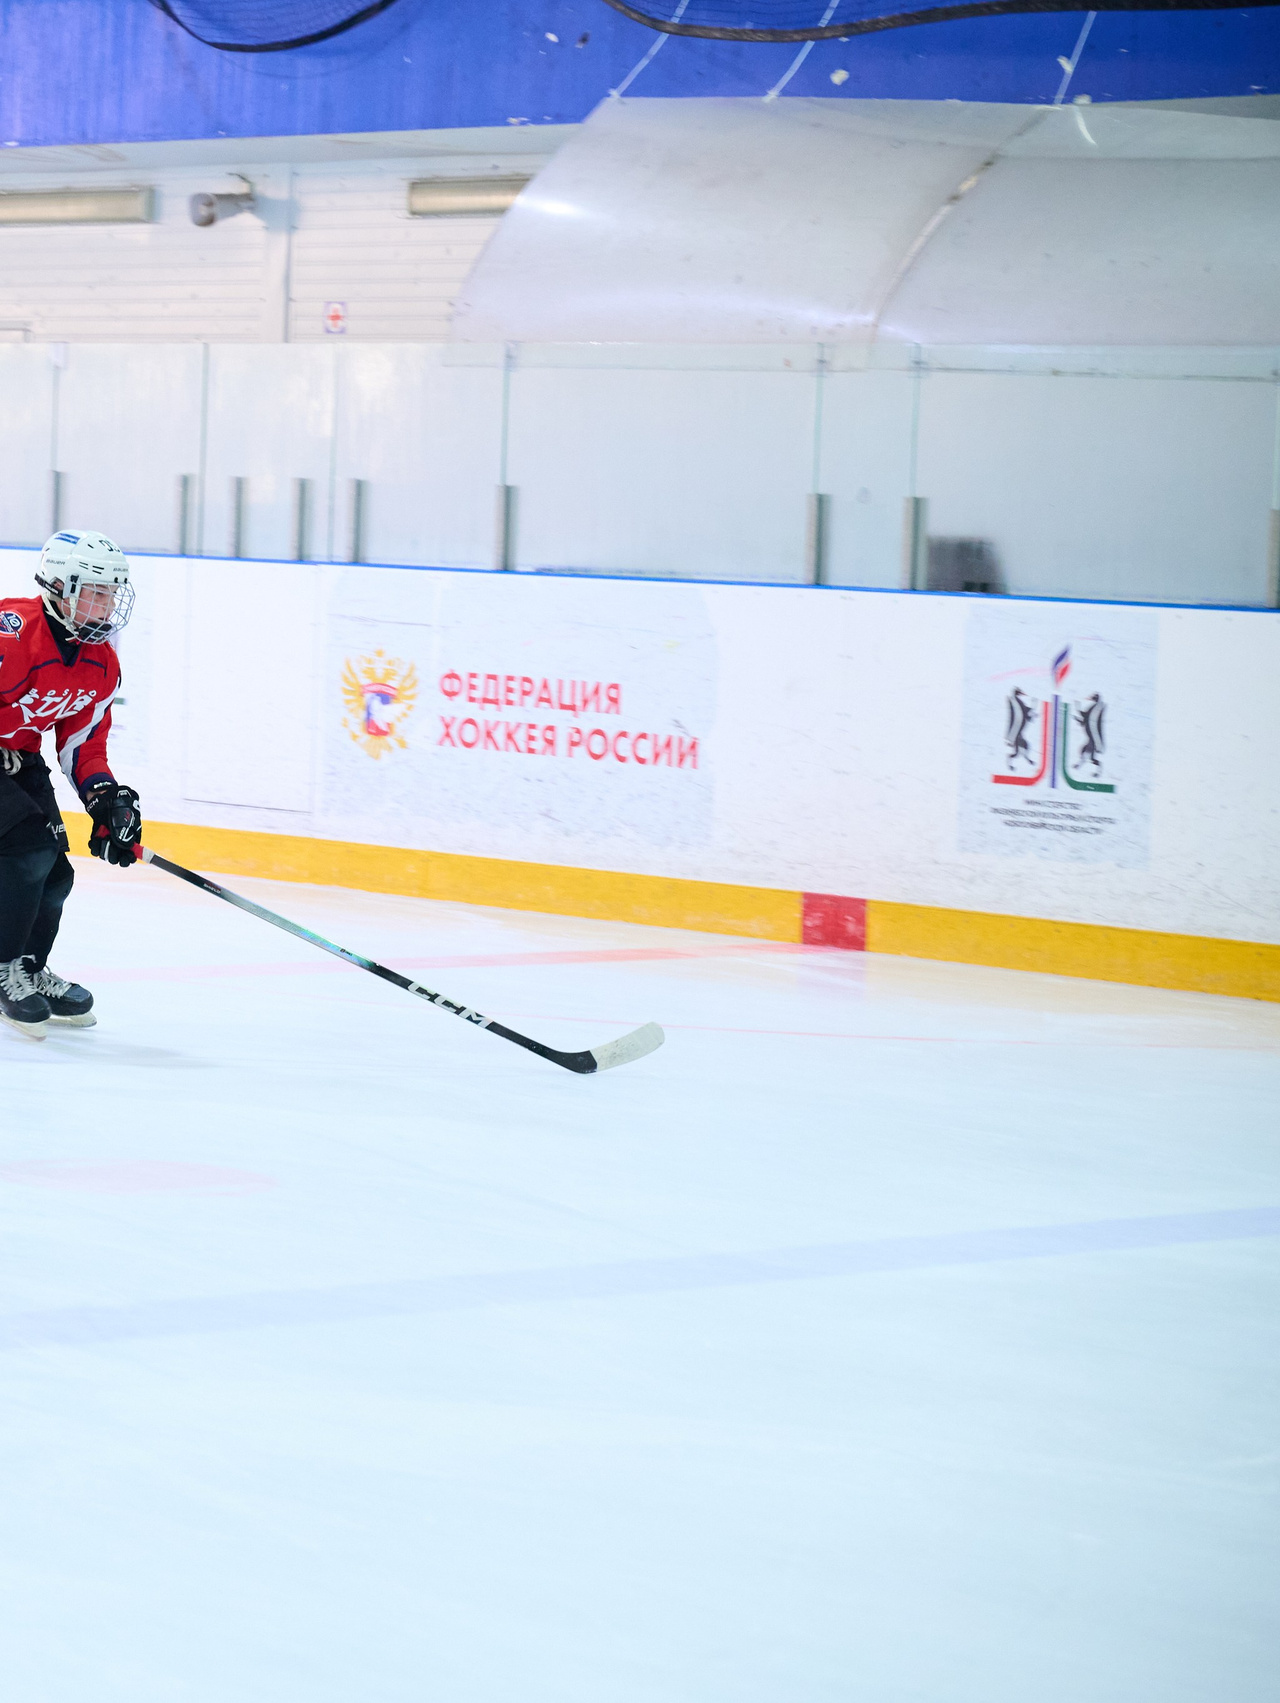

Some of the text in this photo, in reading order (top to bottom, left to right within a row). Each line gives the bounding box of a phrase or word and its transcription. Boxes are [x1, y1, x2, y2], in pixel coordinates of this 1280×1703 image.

[439, 668, 623, 716] ФЕДЕРАЦИЯ
[437, 714, 700, 769] ХОККЕЯ РОССИИ
[407, 980, 494, 1030] CCM
